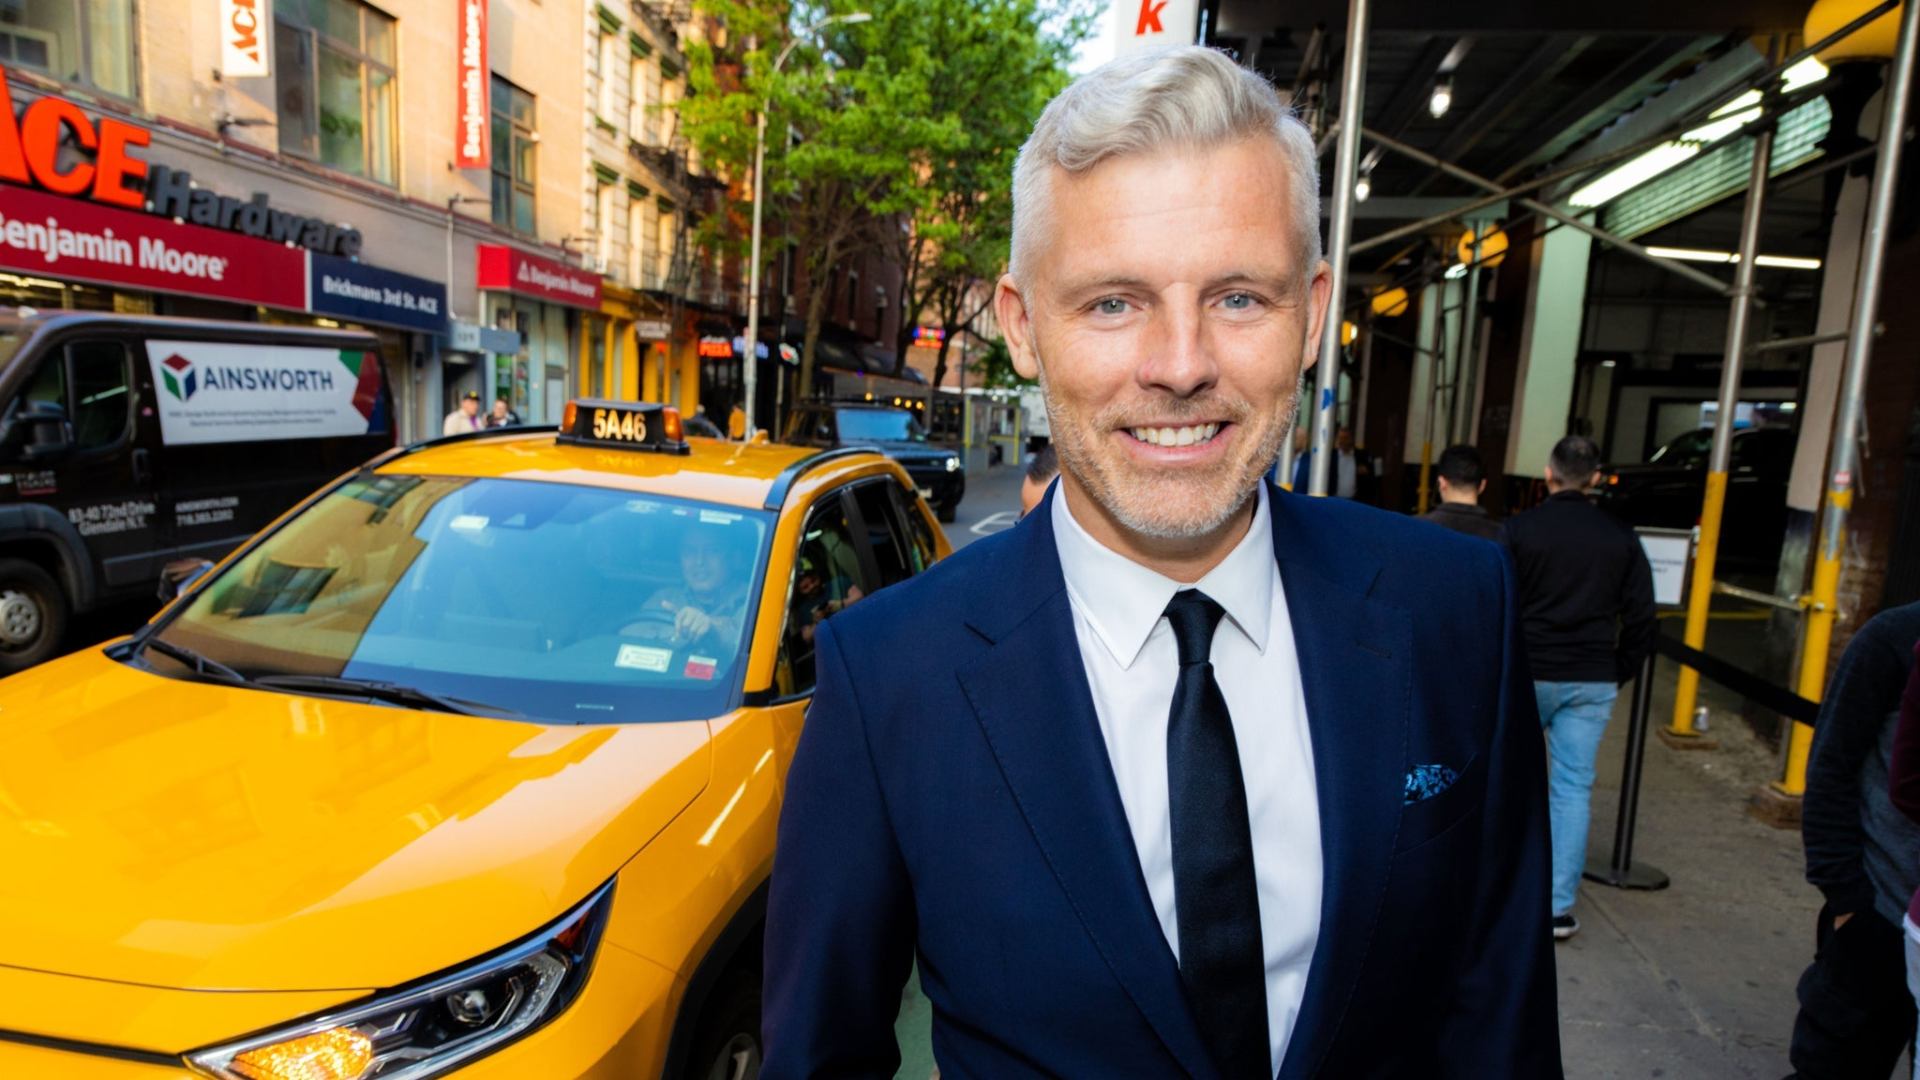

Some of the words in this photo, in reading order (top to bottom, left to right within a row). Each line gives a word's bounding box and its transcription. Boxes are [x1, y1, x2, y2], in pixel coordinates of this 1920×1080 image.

[463, 69, 482, 157] Benjamin
[149, 164, 362, 258] Hardware
[0, 212, 133, 264] enjamin
[322, 274, 381, 303] Brickmans
[383, 287, 401, 307] 3rd
[418, 295, 438, 315] ACE
[203, 366, 334, 393] AINSWORTH
[593, 407, 647, 442] 5A46
